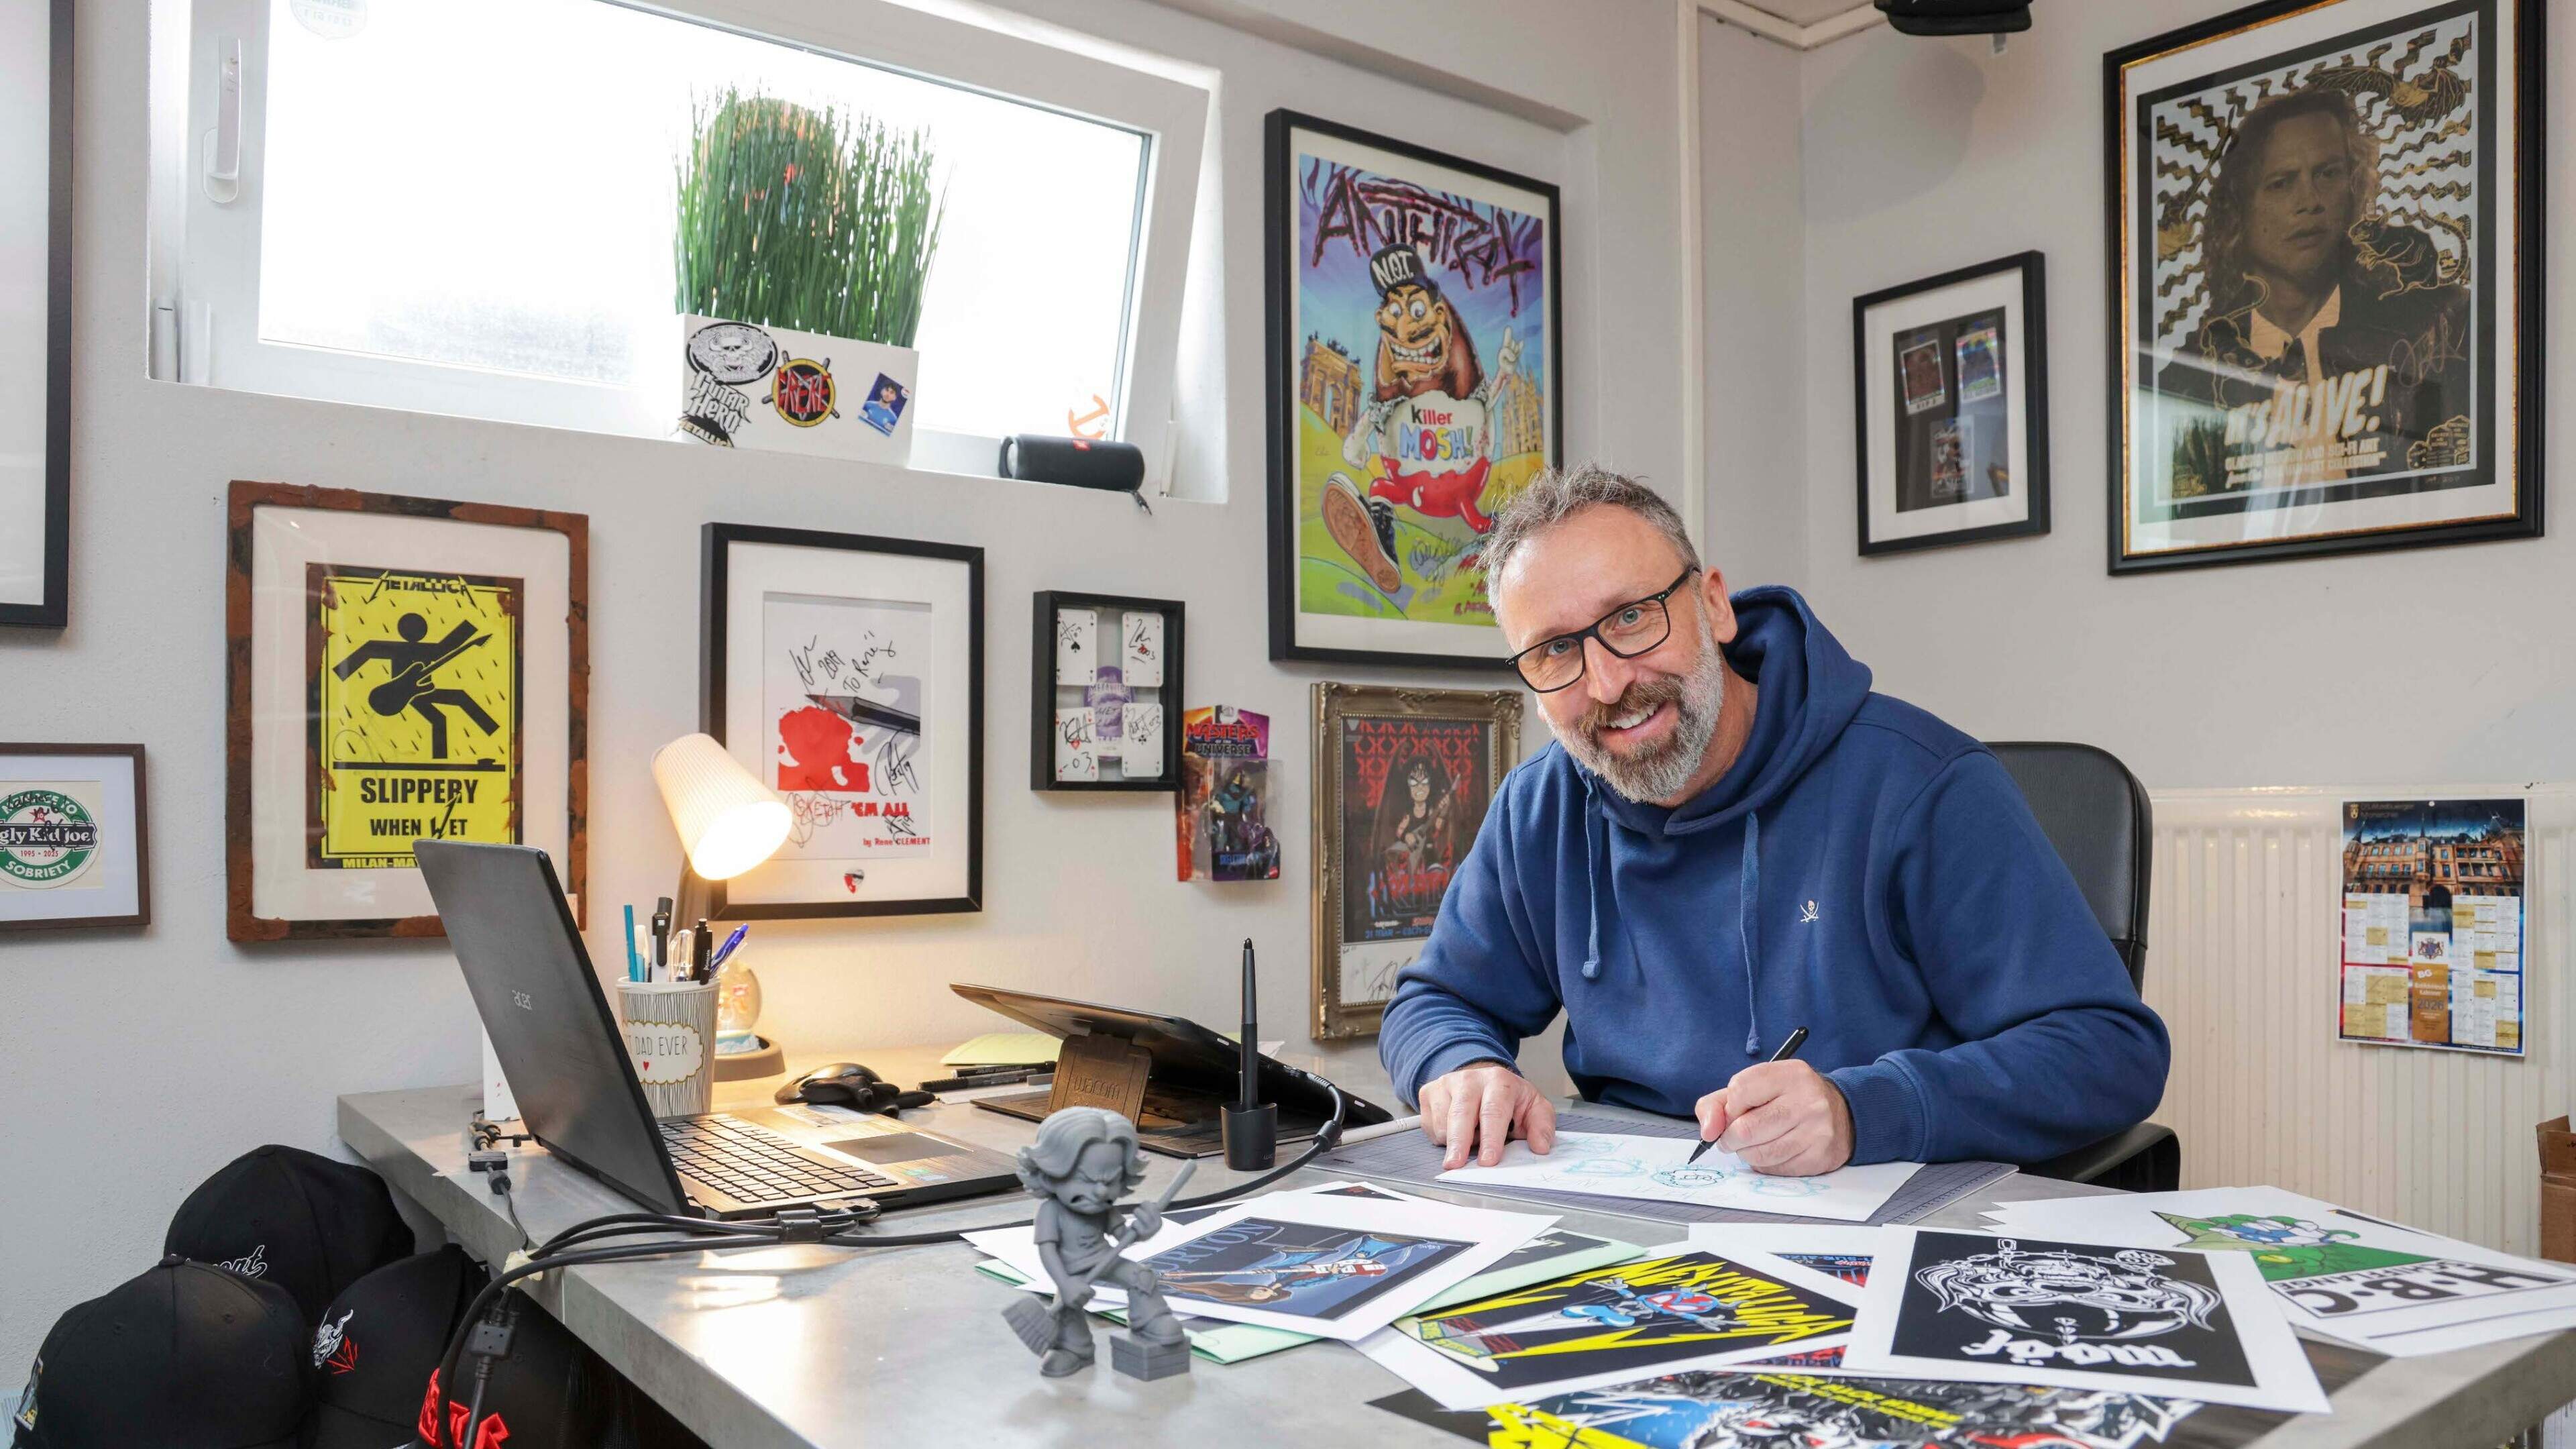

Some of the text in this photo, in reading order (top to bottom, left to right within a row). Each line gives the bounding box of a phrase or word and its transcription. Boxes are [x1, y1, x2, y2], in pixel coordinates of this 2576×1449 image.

[1312, 167, 1536, 317] ANTHRAX
[2265, 364, 2388, 449] ALIVE!
[1399, 423, 1474, 461] MOSH!
[1185, 716, 1260, 743] MASTERS
[1195, 743, 1252, 755] UNIVERSE
[360, 777, 479, 804] SLIPPERY
[882, 802, 910, 817] ALL
[0, 827, 28, 845] gly
[370, 808, 468, 840] WHEN WET
[863, 837, 872, 847] by
[896, 837, 931, 846] CLEMENT
[5, 859, 70, 878] SOBRIETY
[342, 857, 419, 869] MILAN-MA
[635, 1035, 654, 1056] DAD
[658, 1035, 688, 1057] EVER
[1073, 1076, 1120, 1102] wacom
[1152, 1219, 1275, 1272] URTON
